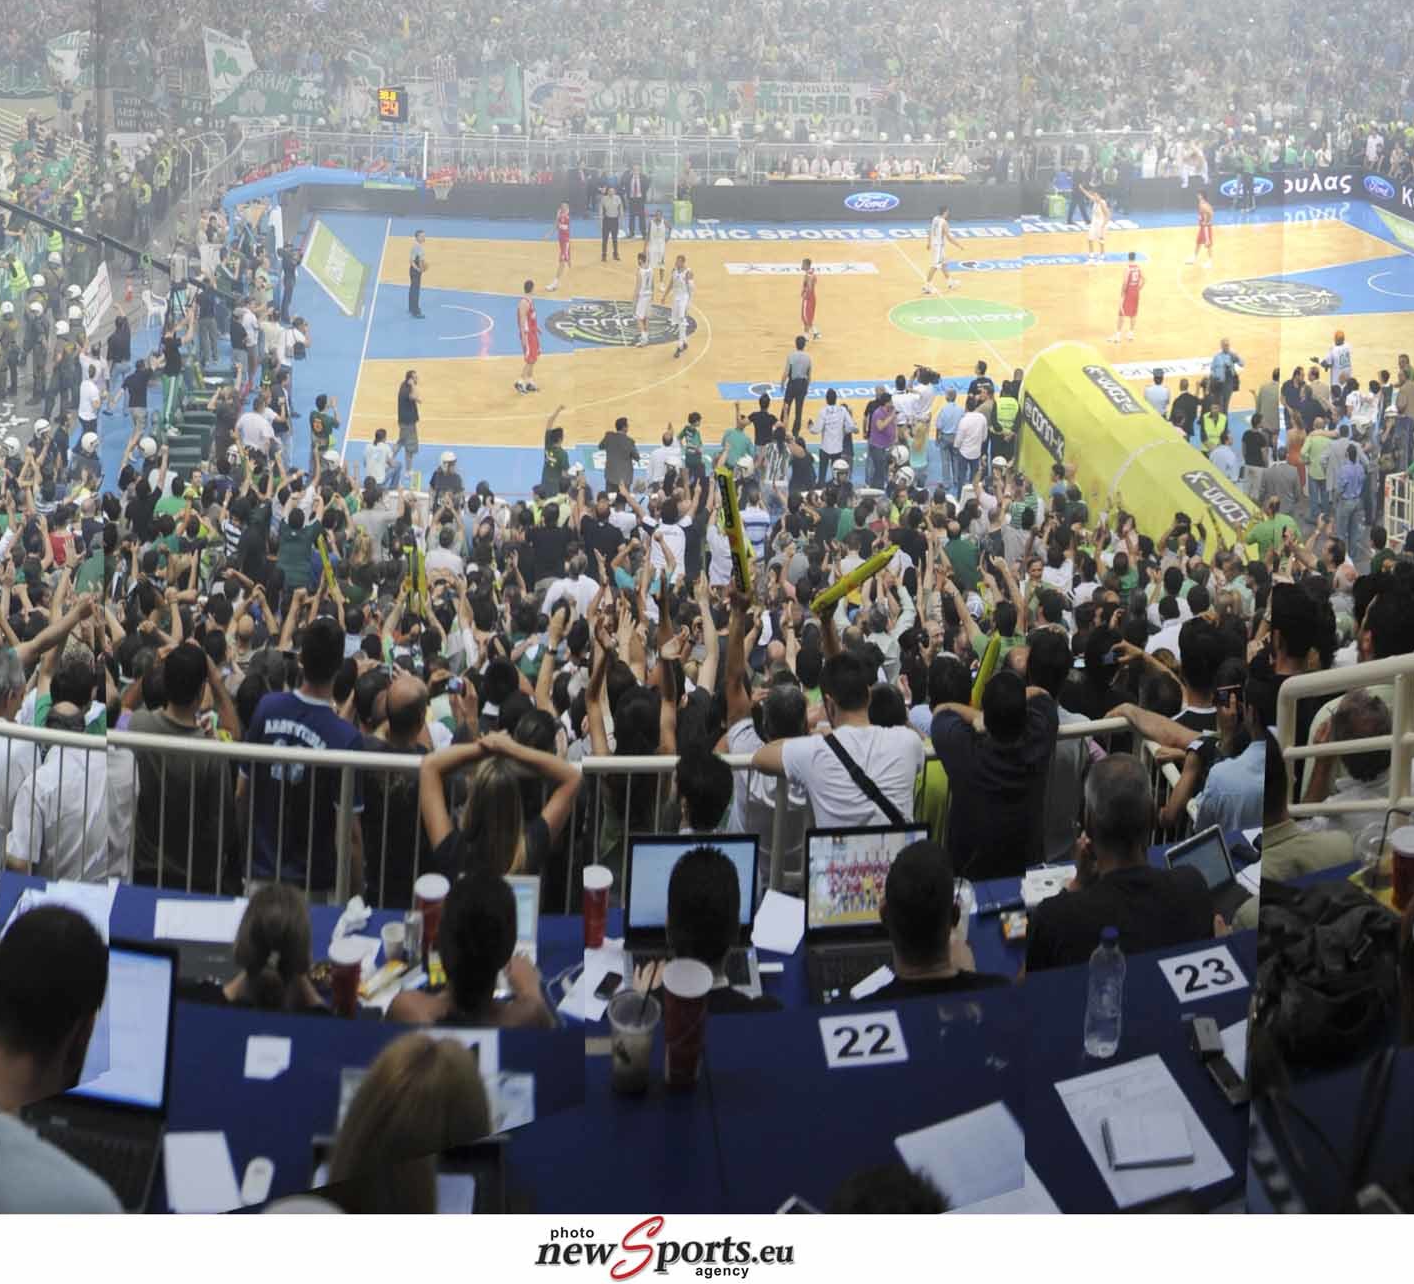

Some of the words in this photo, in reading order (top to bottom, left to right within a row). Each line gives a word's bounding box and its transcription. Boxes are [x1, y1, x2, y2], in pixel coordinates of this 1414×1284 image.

[853, 195, 889, 209] Ford
[756, 228, 884, 240] SPORTS
[888, 227, 1013, 239] CENTER
[1174, 956, 1234, 994] 23
[832, 1023, 896, 1058] 22
